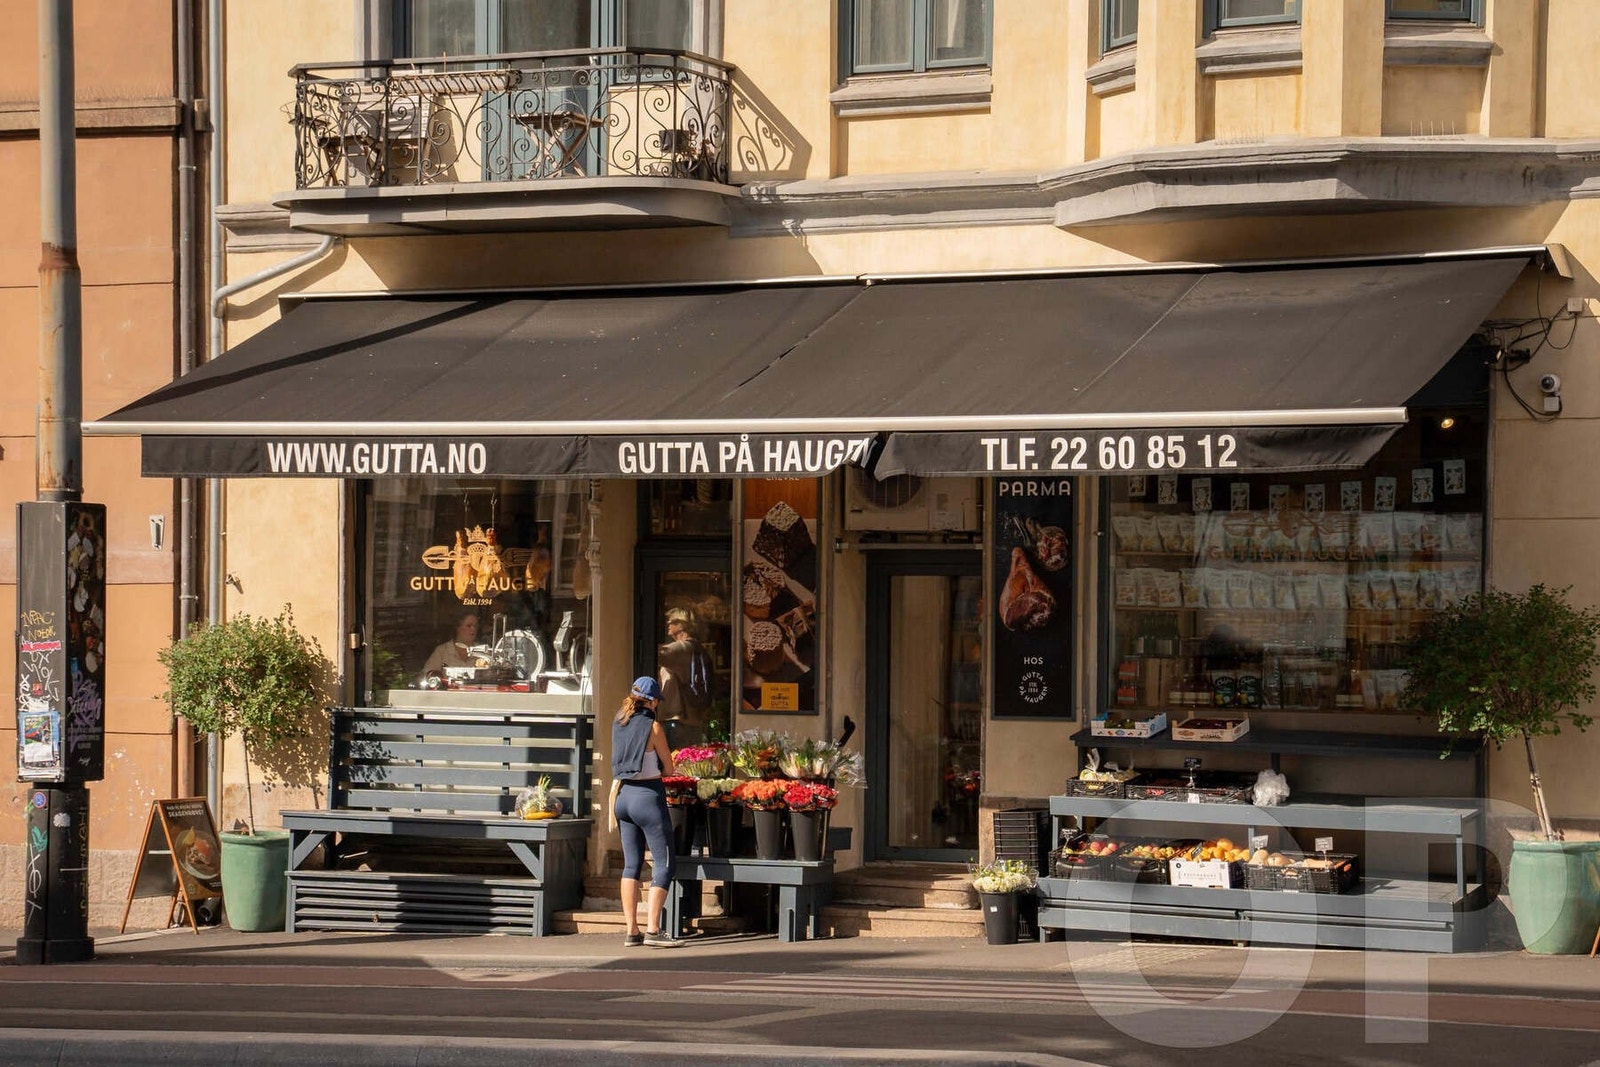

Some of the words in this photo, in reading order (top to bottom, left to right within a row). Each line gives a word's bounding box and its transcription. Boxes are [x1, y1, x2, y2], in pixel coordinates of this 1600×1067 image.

[267, 442, 487, 474] WWW.GUTTA.NO
[618, 441, 710, 474] GUTTA
[718, 433, 755, 473] PÅ
[980, 437, 1039, 471] TLF.
[1050, 437, 1088, 470] 22
[1098, 436, 1136, 470] 60
[1147, 435, 1187, 469] 85
[1197, 434, 1238, 468] 12
[999, 480, 1071, 497] PARMA
[410, 576, 455, 591] GUTT
[1023, 656, 1044, 665] HOS
[1022, 671, 1044, 682] GUTTA
[1024, 685, 1048, 703] HAUGEN
